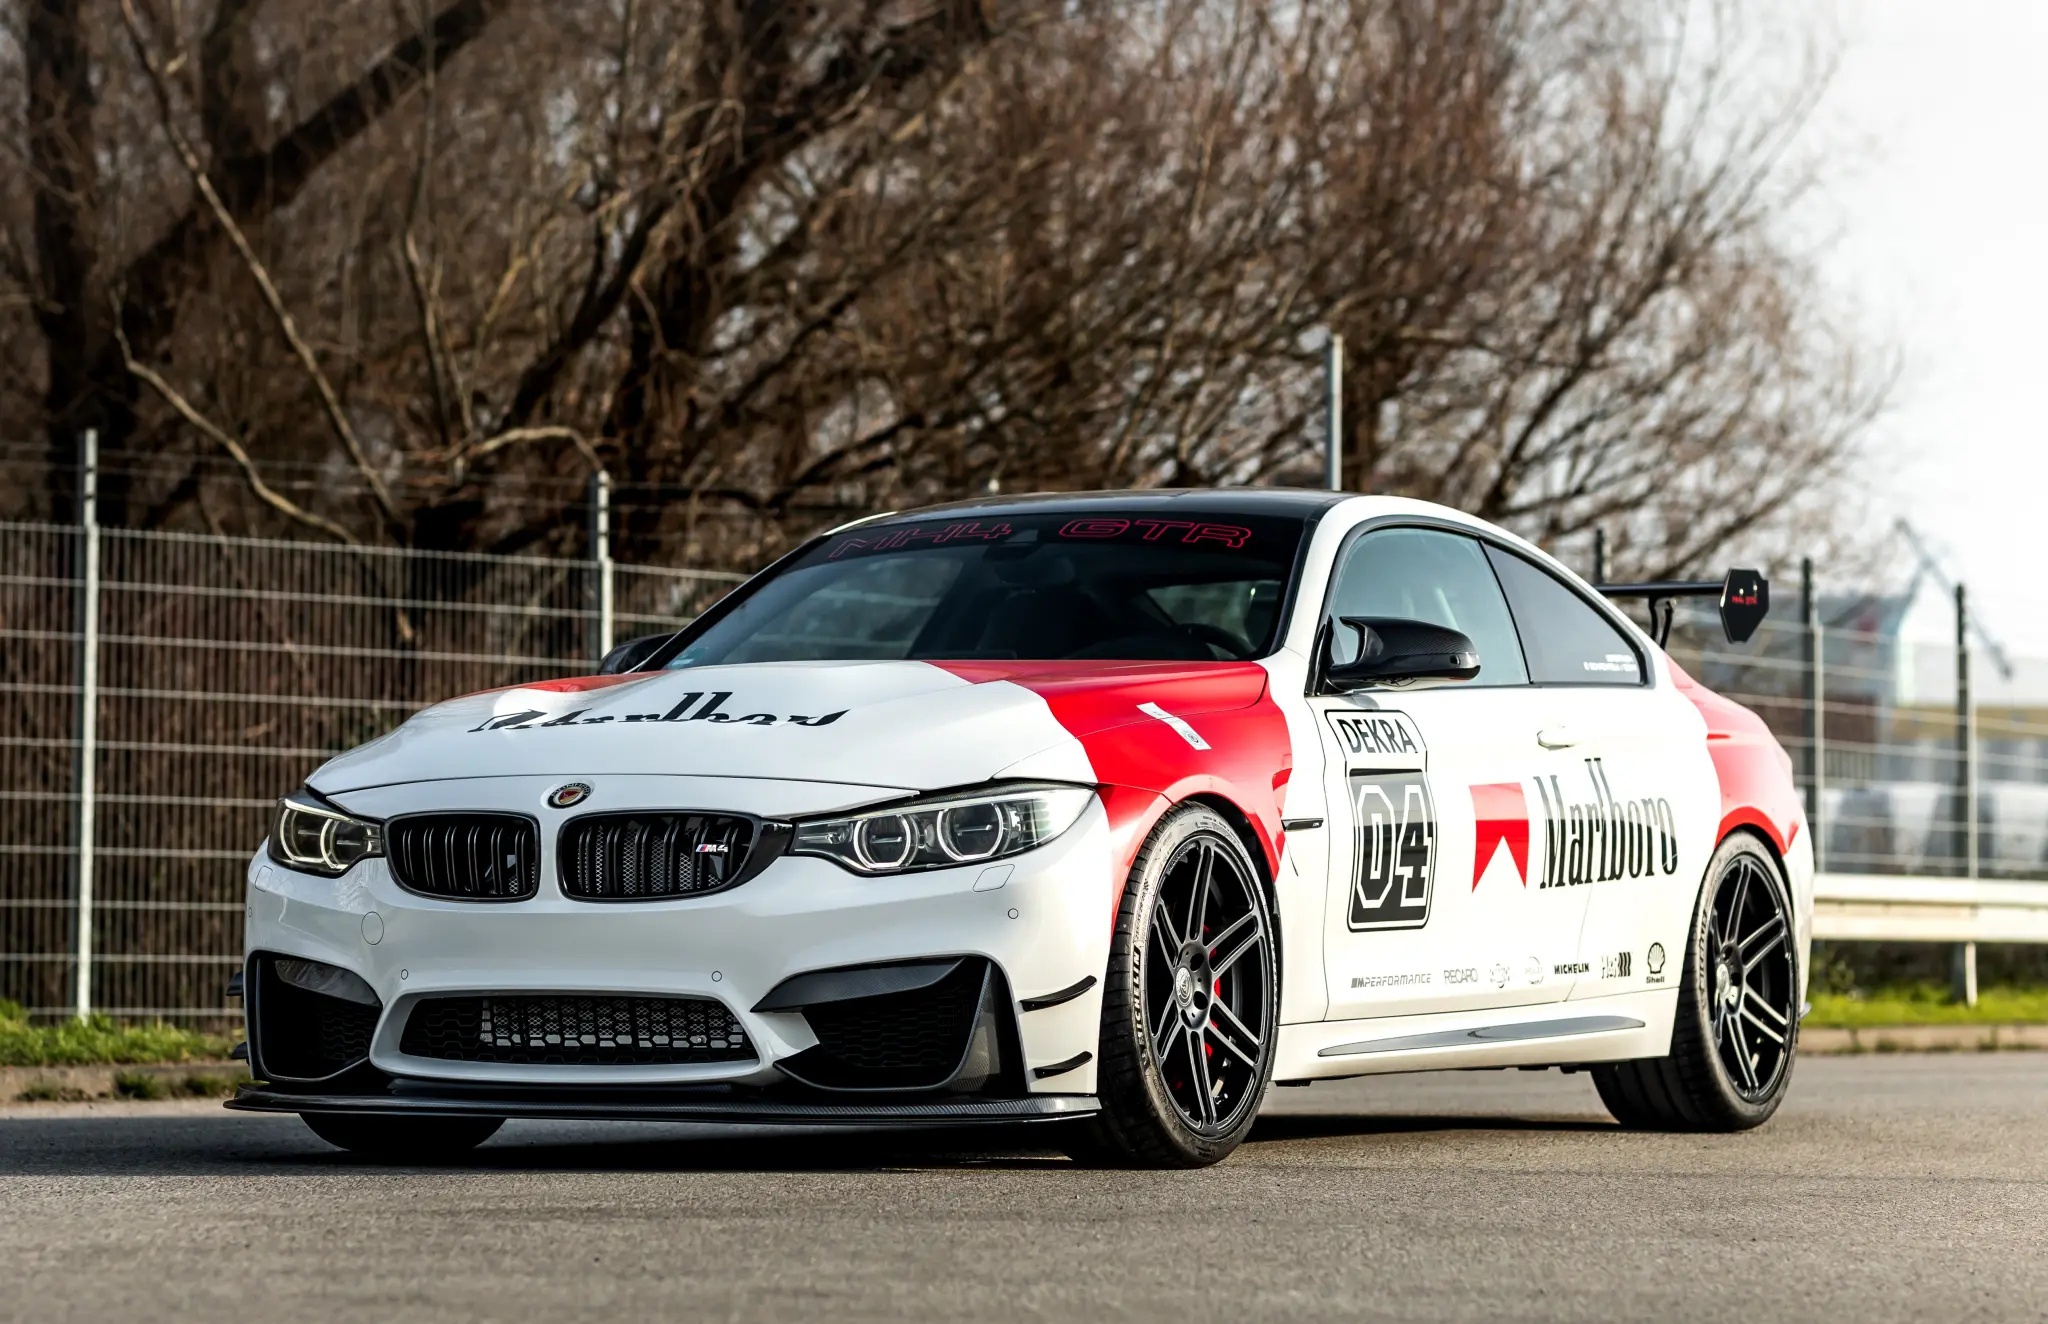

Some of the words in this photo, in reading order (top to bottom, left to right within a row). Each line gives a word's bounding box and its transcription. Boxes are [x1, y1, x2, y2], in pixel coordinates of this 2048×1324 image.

[828, 522, 1012, 559] MH4
[1059, 518, 1252, 549] GTR
[1337, 718, 1418, 754] DEKRA
[1533, 757, 1678, 889] Marlboro
[1355, 783, 1433, 910] 04
[1443, 967, 1479, 984] RECARO
[1553, 962, 1590, 975] MICHELIN
[1645, 976, 1665, 984] Shell
[1132, 952, 1145, 1045] MICHELIN
